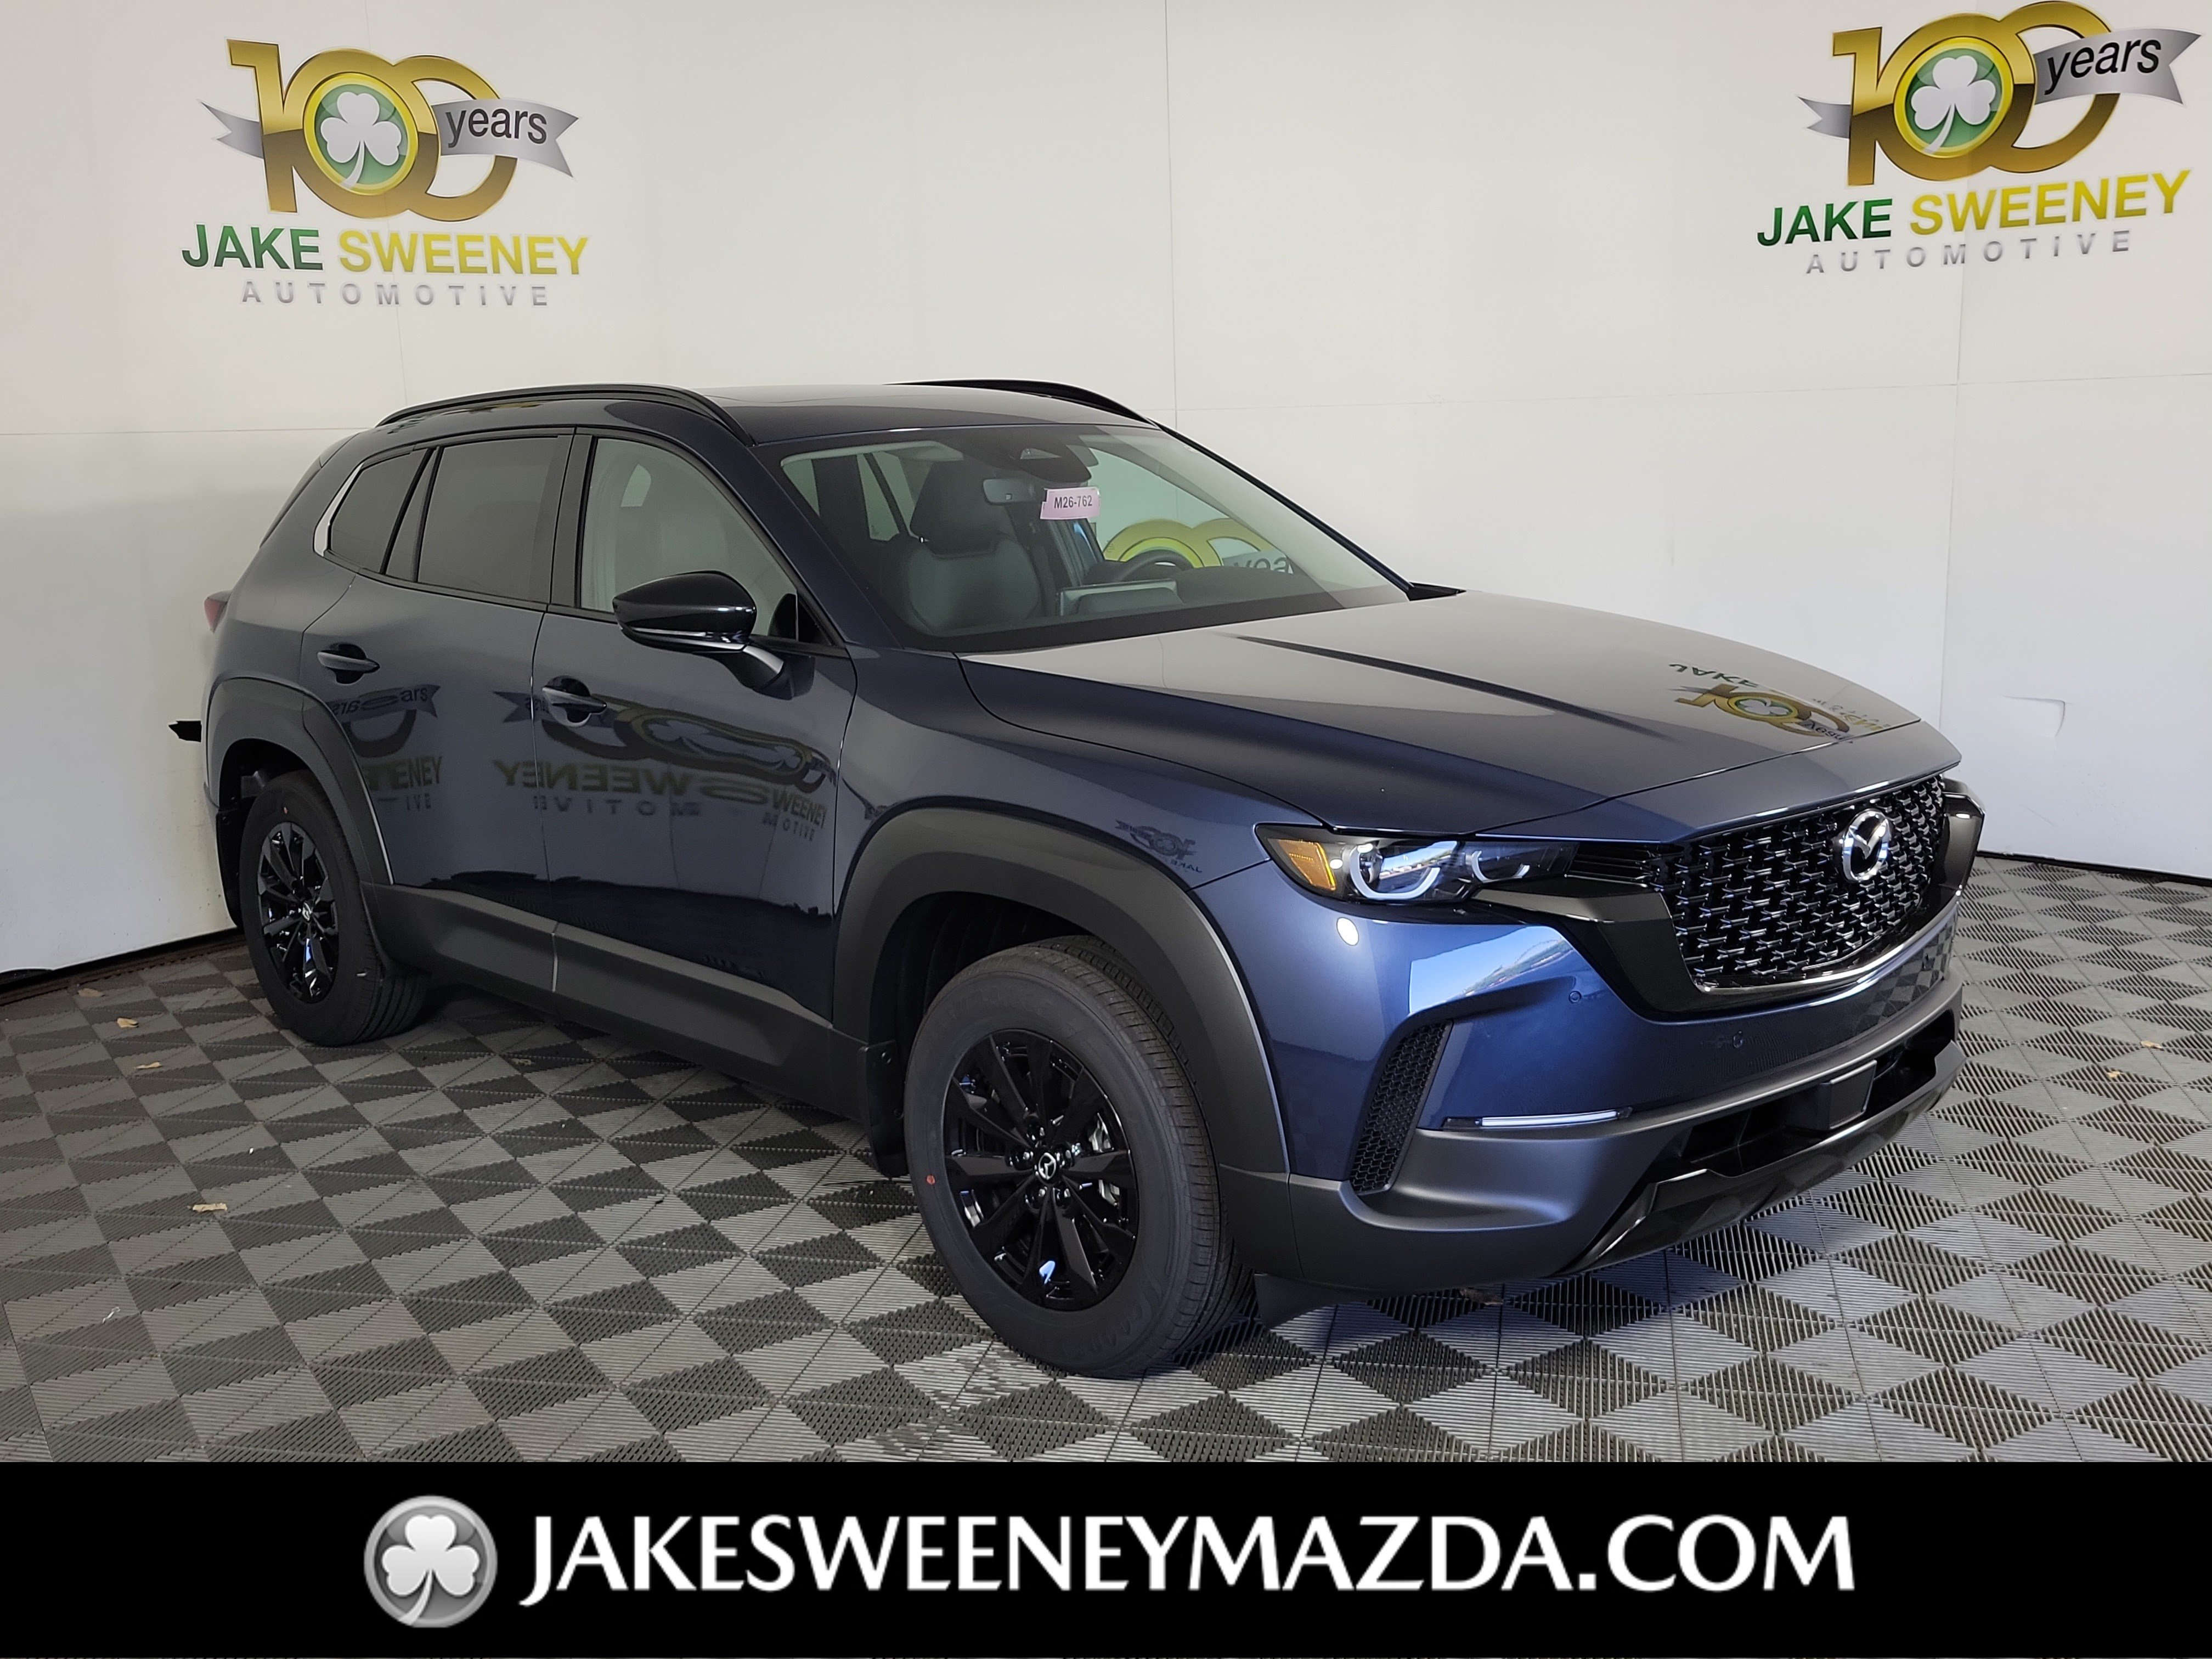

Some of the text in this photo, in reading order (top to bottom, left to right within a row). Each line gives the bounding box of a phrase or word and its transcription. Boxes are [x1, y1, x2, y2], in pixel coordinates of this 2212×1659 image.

[1832, 1, 2162, 187] 100 years
[226, 39, 547, 222] 100 years
[1757, 170, 2191, 246] JAKE SWEENEY
[182, 224, 588, 275] JAKE SWEENEY
[1805, 230, 2130, 274] AUTOMOTIVE
[242, 281, 548, 306] AUTOMOTIVE
[1054, 495, 1093, 509] M26-762
